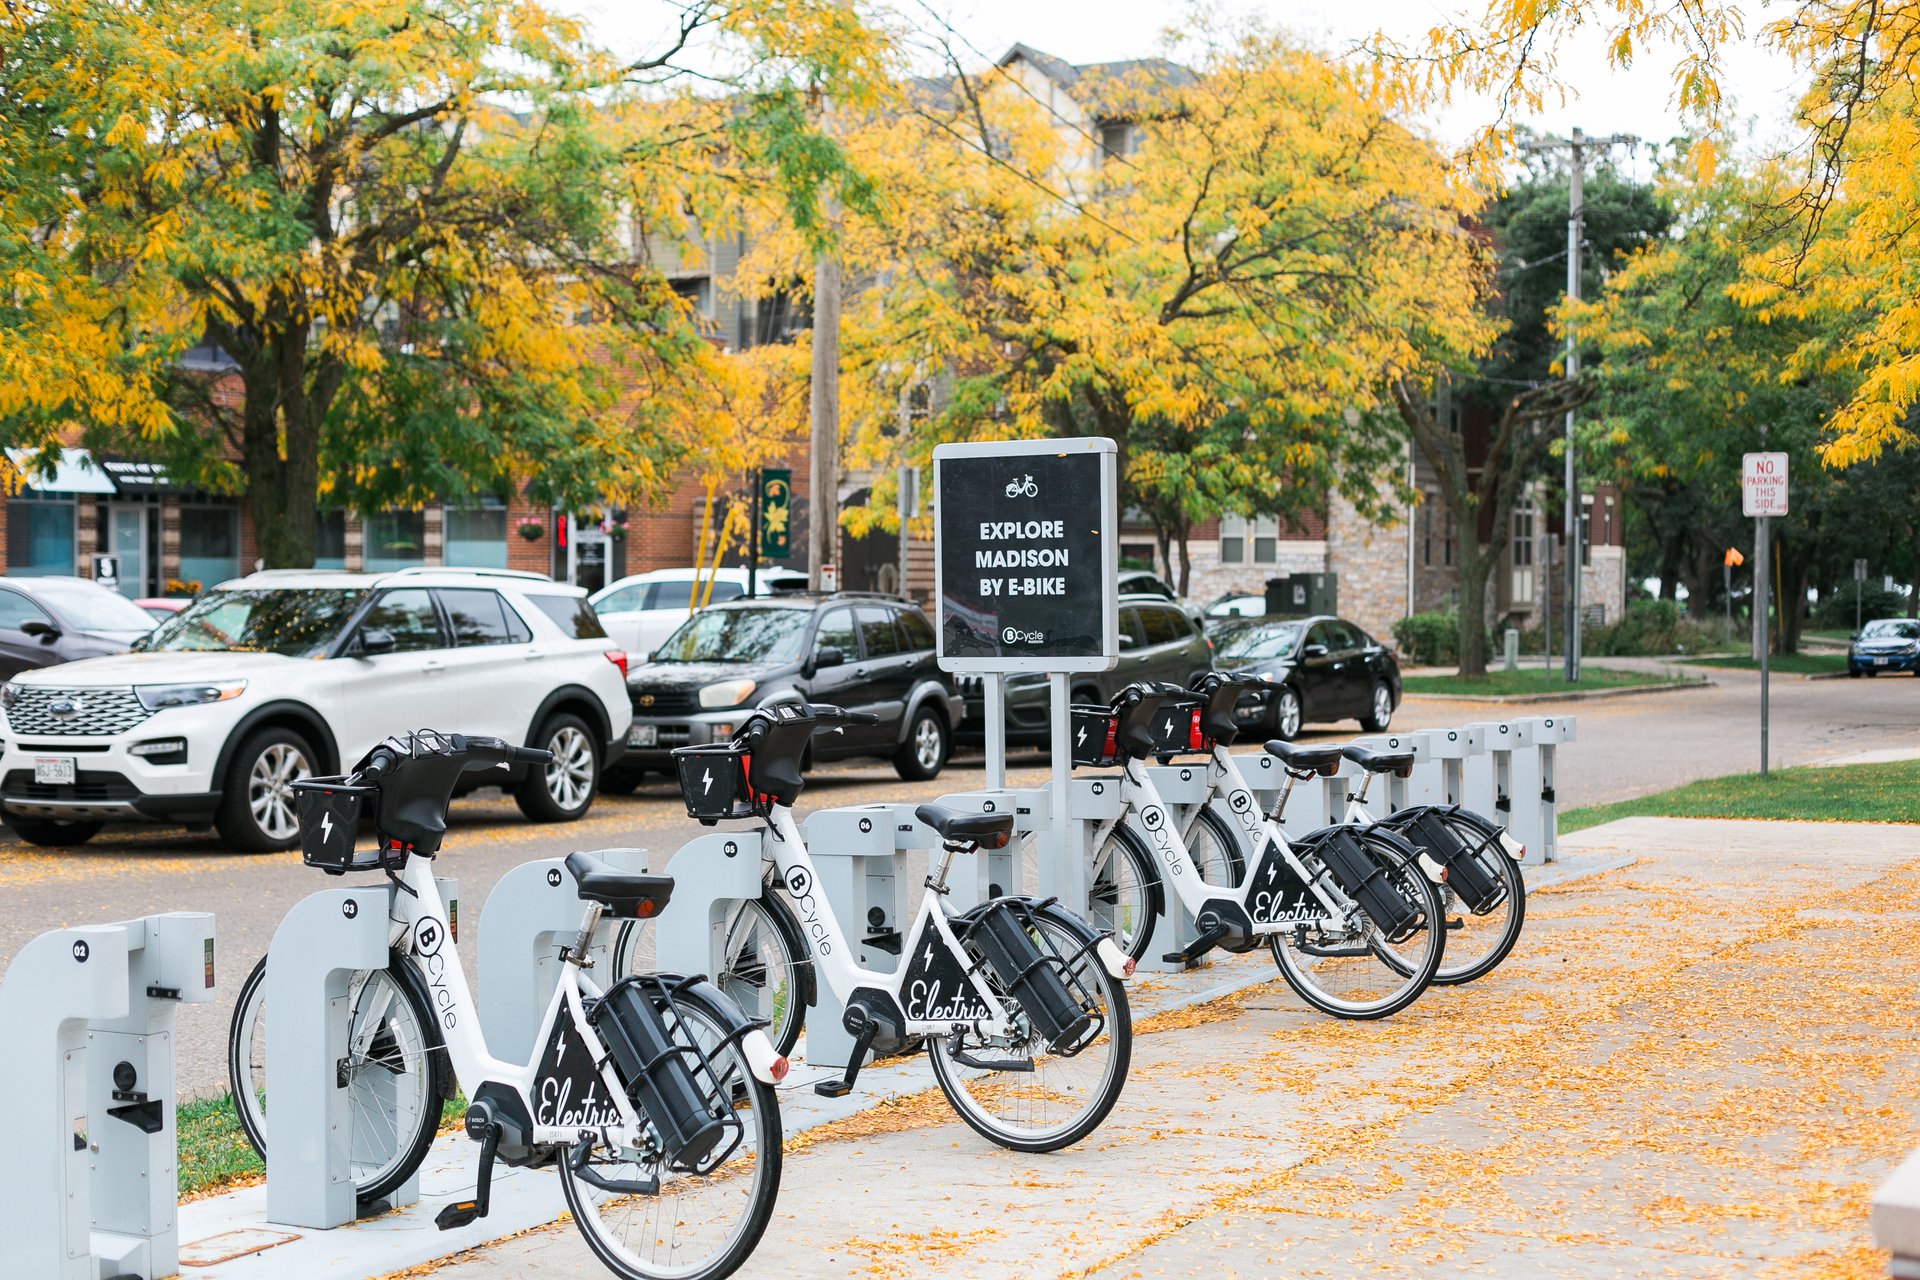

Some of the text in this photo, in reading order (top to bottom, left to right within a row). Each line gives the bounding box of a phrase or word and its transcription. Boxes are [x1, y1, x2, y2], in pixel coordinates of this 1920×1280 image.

[1756, 460, 1774, 474] NO
[1746, 476, 1784, 486] PARKING
[1755, 487, 1776, 498] THIS
[1755, 499, 1775, 509] SIDE
[980, 520, 1064, 540] EXPLORE
[975, 549, 1069, 568] MADISON
[980, 577, 1066, 596] BY E-BIKE
[860, 821, 870, 830] 06
[724, 845, 736, 854] 05
[548, 873, 560, 882] 04
[343, 903, 355, 914] 03
[1253, 890, 1328, 922] Electric
[74, 945, 86, 957] 02
[907, 979, 989, 1020] Electric
[538, 1076, 621, 1127] Electric
